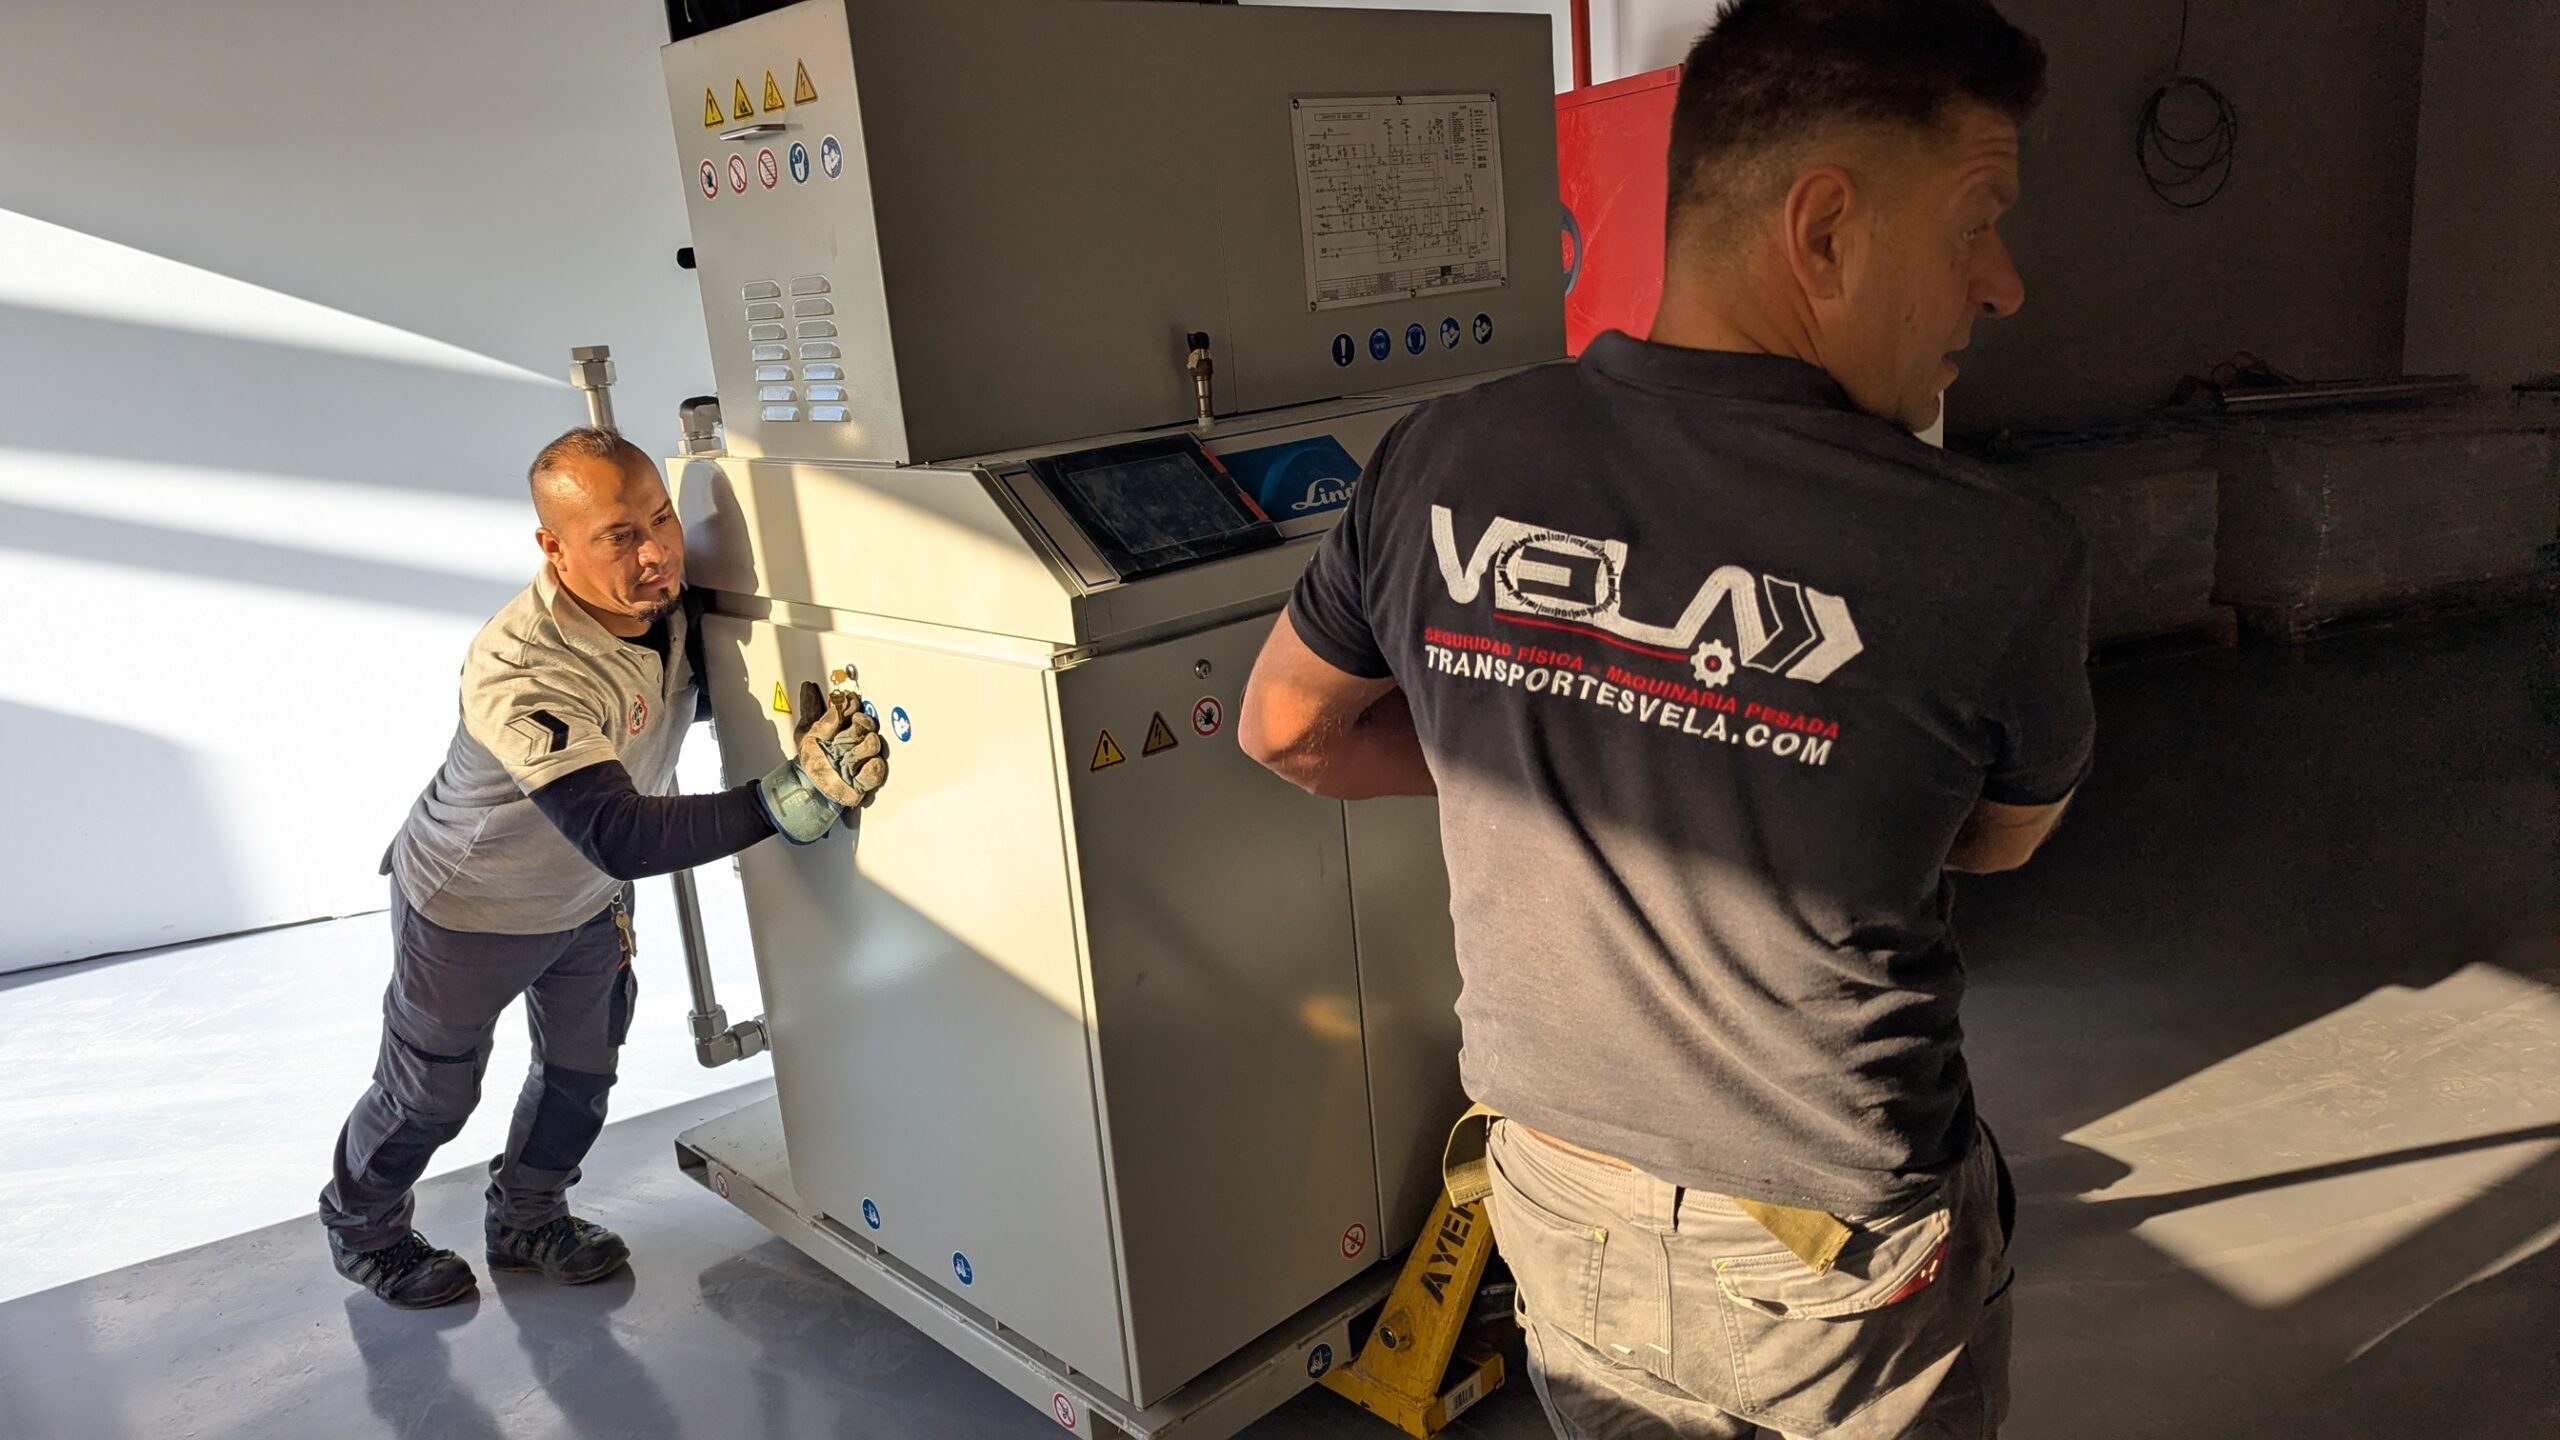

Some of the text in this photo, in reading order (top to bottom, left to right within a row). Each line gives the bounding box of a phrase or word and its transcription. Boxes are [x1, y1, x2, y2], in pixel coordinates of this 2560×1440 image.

[1431, 504, 1769, 667] VELA
[1424, 627, 1512, 656] SEGURIDAD
[1517, 645, 1584, 671] FÍSICA
[1606, 665, 1738, 714] MAQUINARIA
[1744, 703, 1840, 740] PESADA
[1424, 645, 1833, 766] TRANSPORTESVELA.COM
